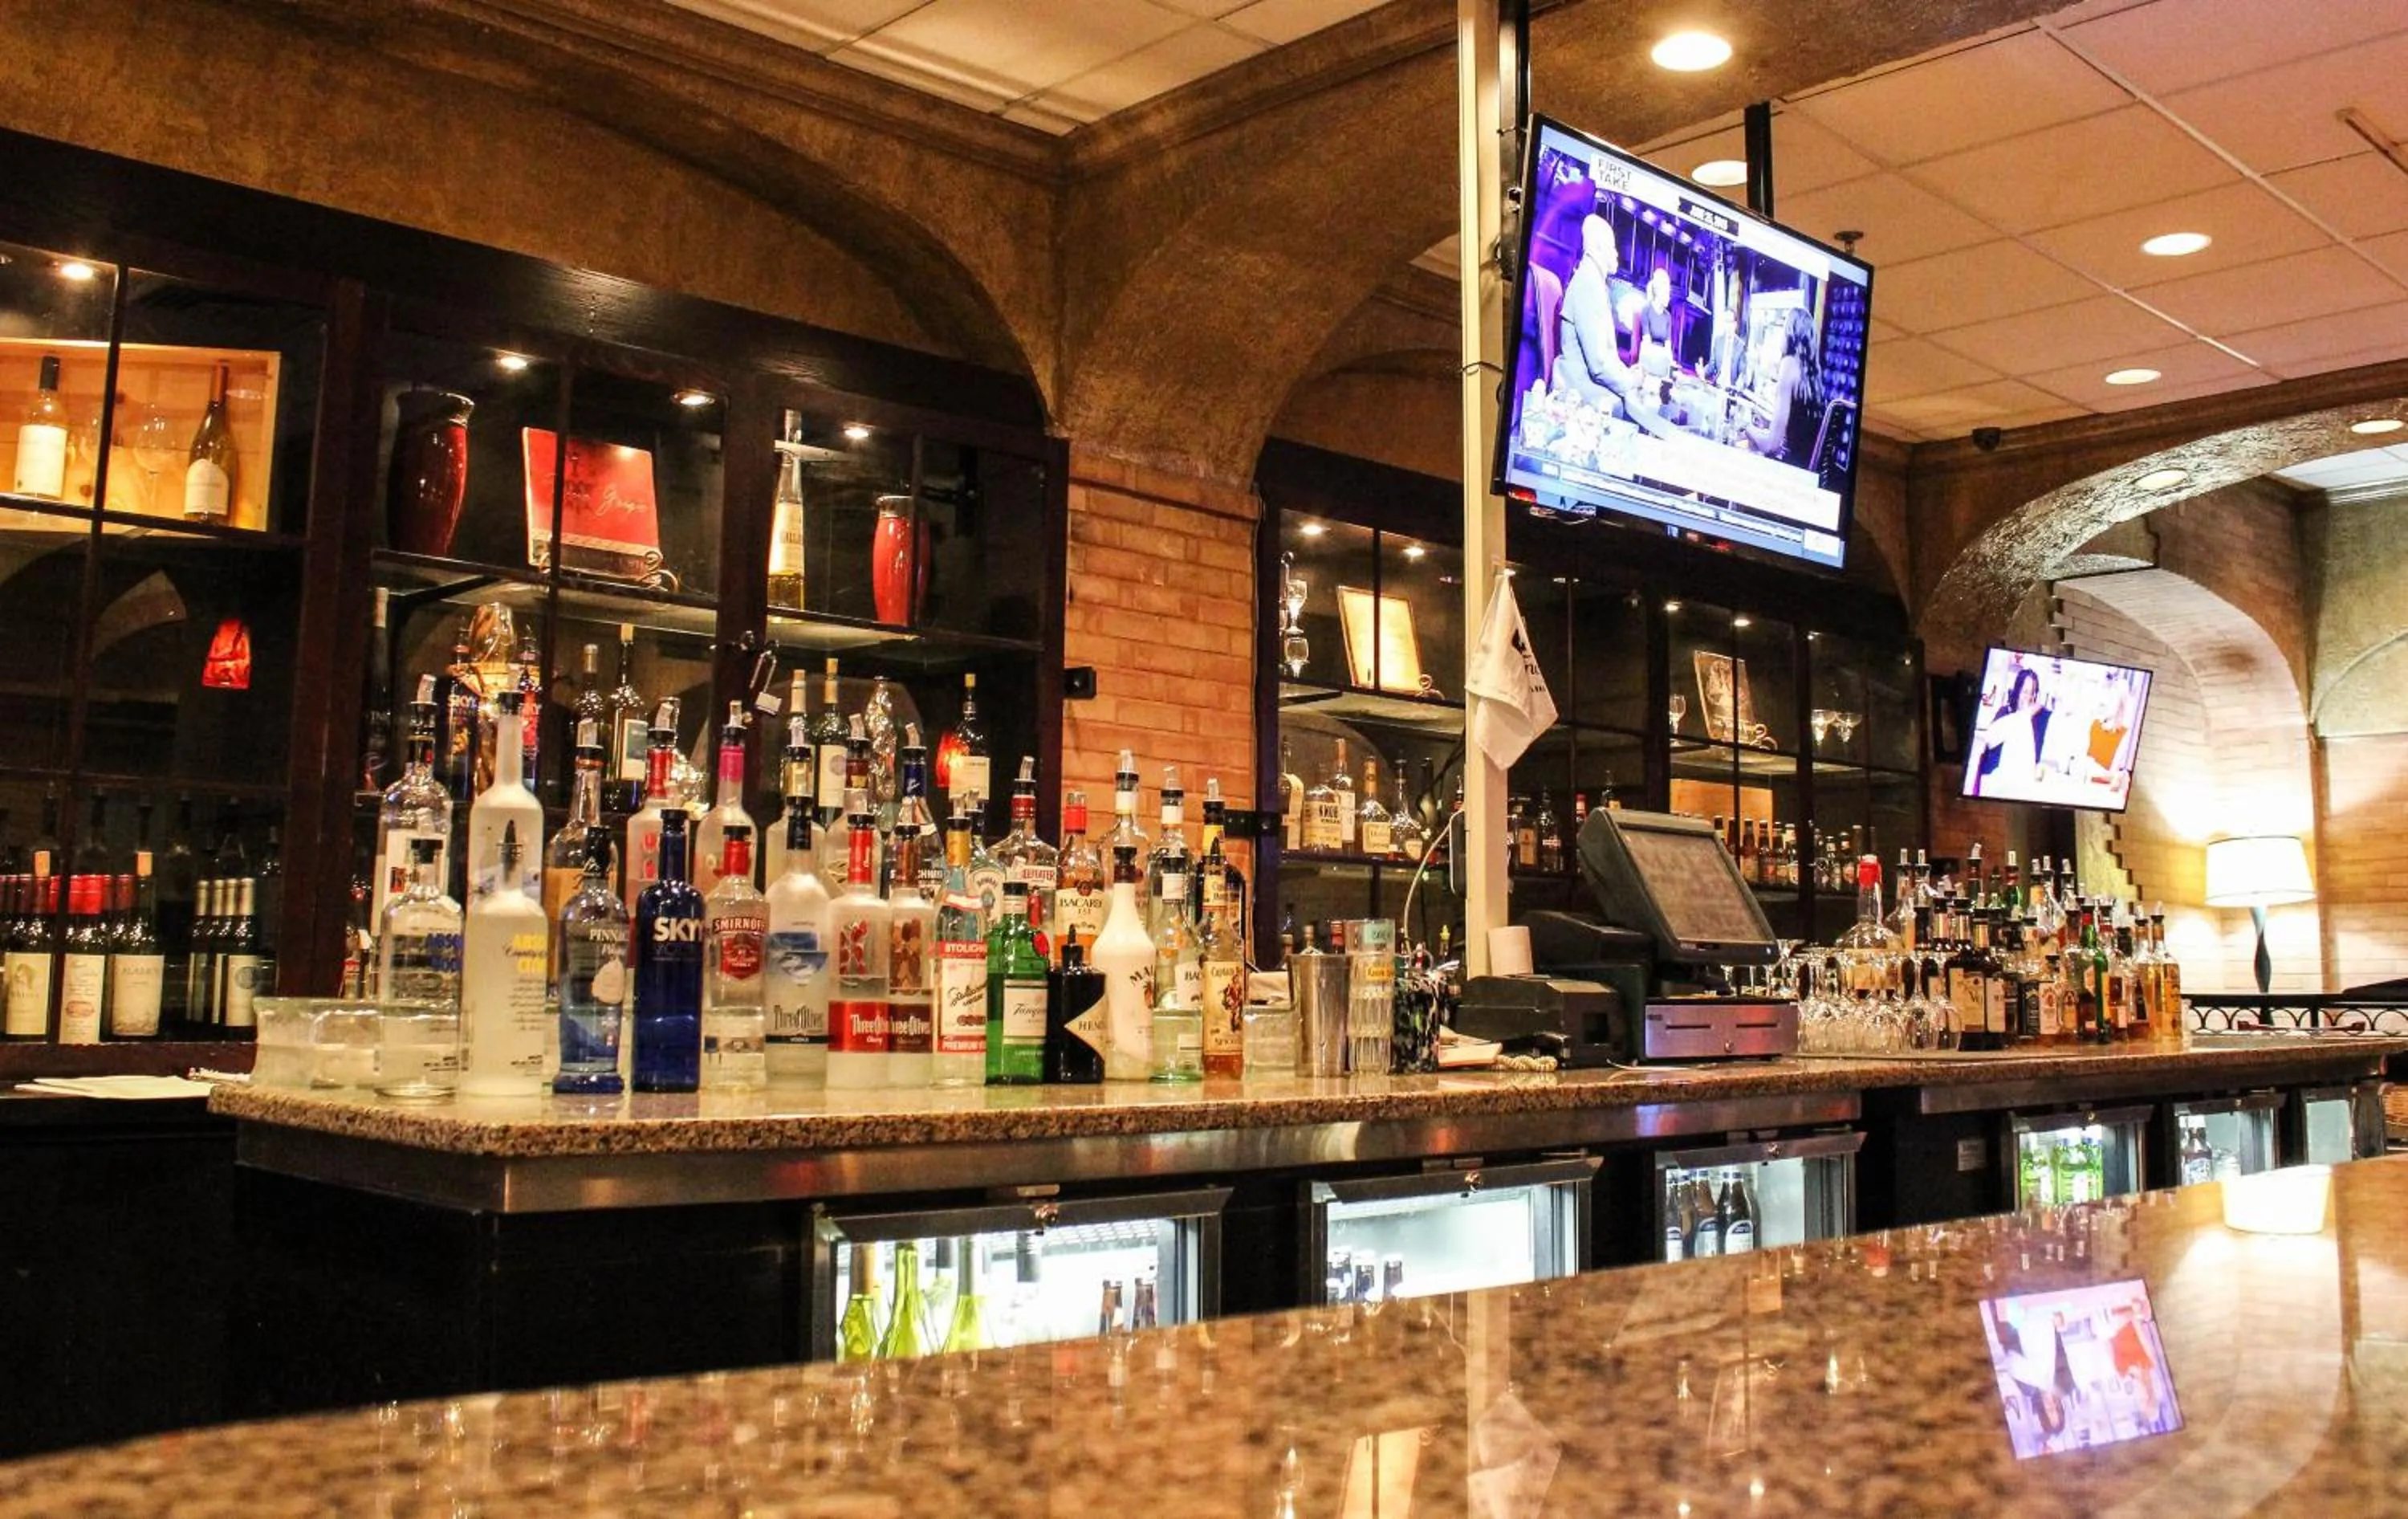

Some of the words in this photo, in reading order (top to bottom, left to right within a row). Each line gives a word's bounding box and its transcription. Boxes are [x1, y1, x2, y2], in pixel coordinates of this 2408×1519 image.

[1597, 157, 1632, 181] FIRST
[1599, 171, 1629, 192] TAKE
[1019, 868, 1055, 882] EEFEATER
